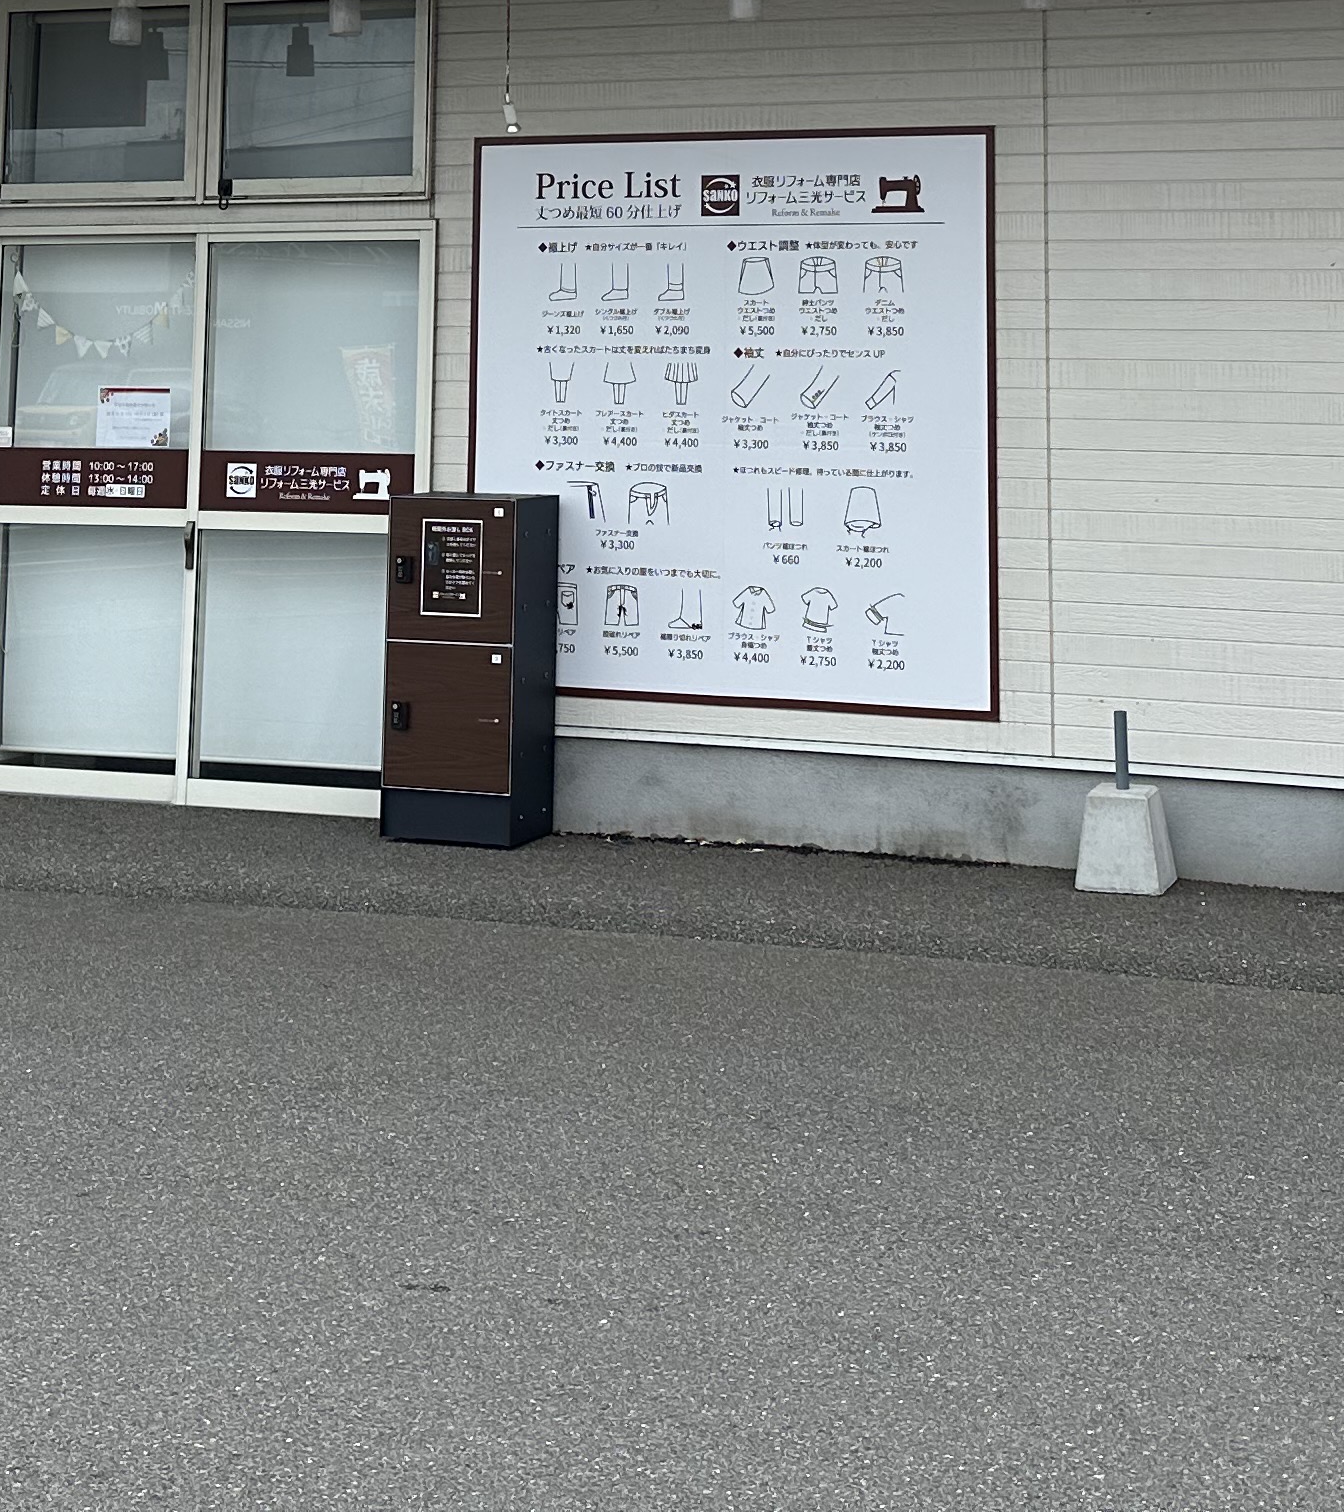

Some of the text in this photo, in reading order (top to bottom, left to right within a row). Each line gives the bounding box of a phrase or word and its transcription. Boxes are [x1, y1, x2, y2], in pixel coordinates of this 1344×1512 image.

[535, 171, 682, 200] Price List
[752, 174, 861, 188] 衣服リフォーム専門店
[746, 190, 867, 205] リフォーム三光サービス
